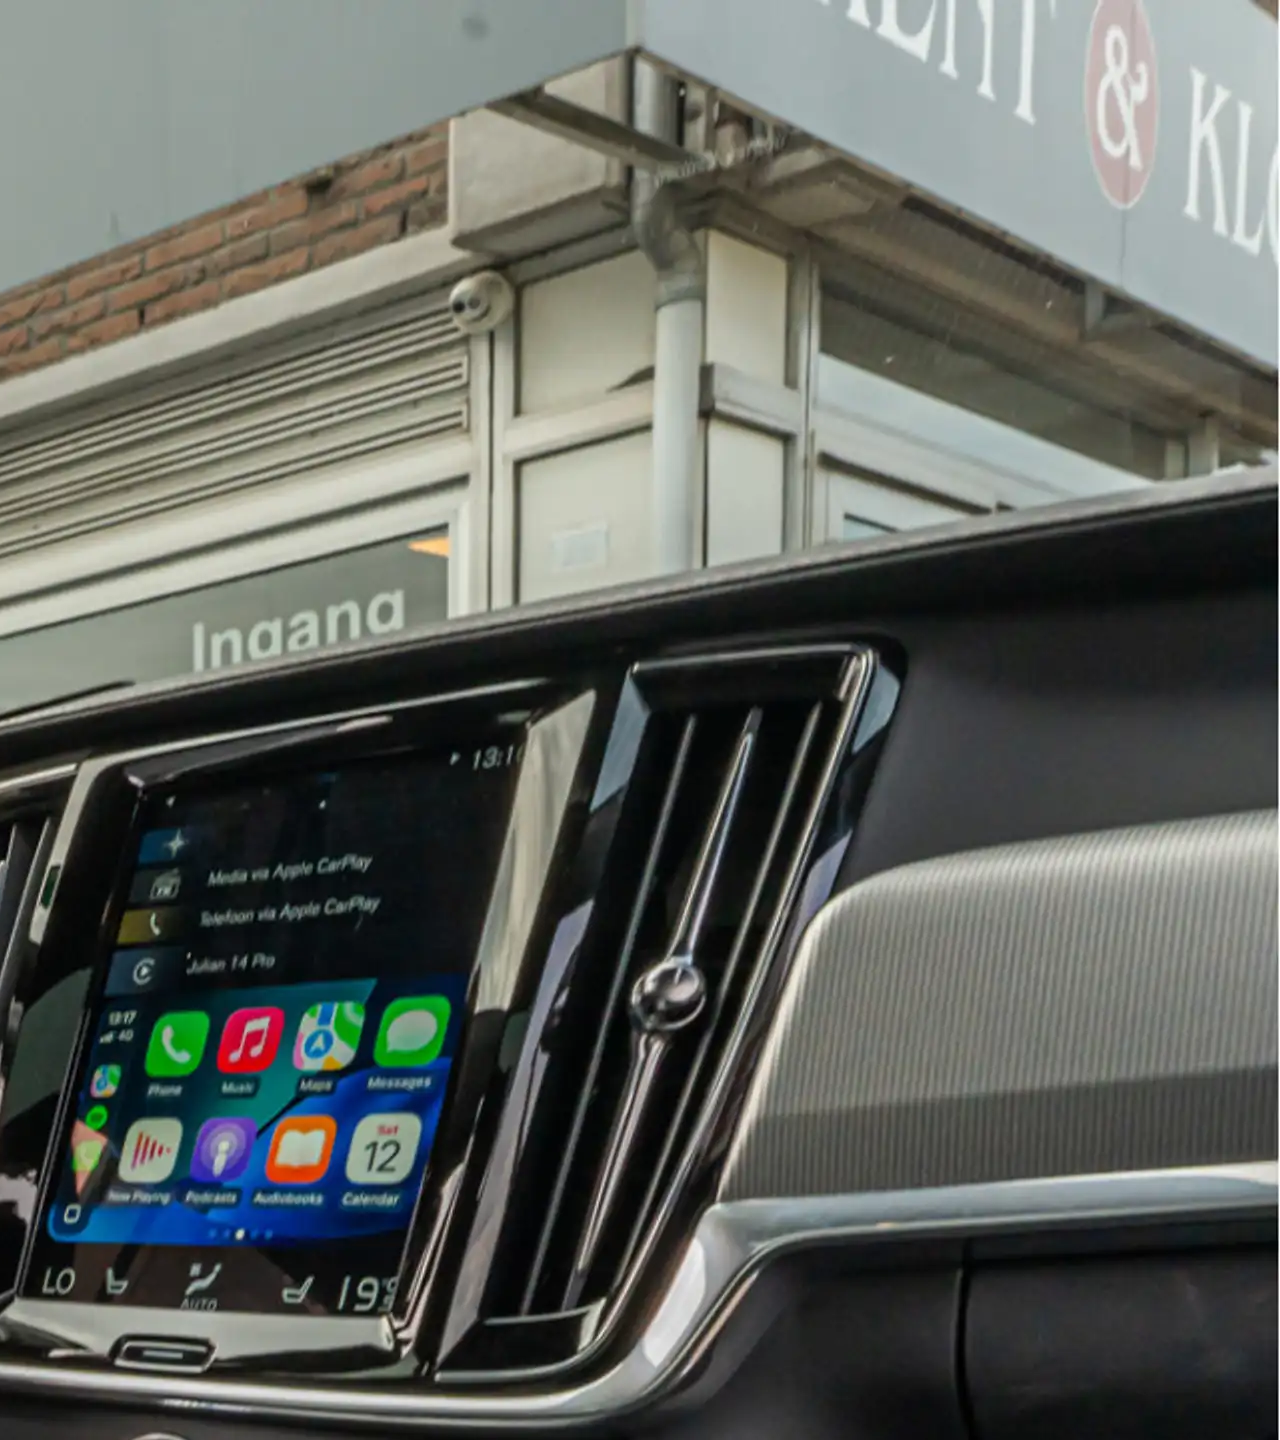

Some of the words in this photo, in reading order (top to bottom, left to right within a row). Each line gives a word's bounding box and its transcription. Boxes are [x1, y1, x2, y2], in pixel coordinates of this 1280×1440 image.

[1095, 24, 1148, 168] &
[192, 588, 405, 674] Ingang
[272, 861, 314, 882] Apple
[317, 853, 373, 874] CarPlay
[199, 908, 255, 928] Telefoon
[258, 905, 276, 922] via
[279, 901, 321, 922] Apple
[323, 895, 382, 915] CarPlay
[367, 1076, 432, 1091] Messages
[364, 1139, 402, 1174] 12
[253, 1190, 324, 1206] Audiobooks
[341, 1191, 400, 1207] Calendar
[41, 1267, 77, 1296] LO
